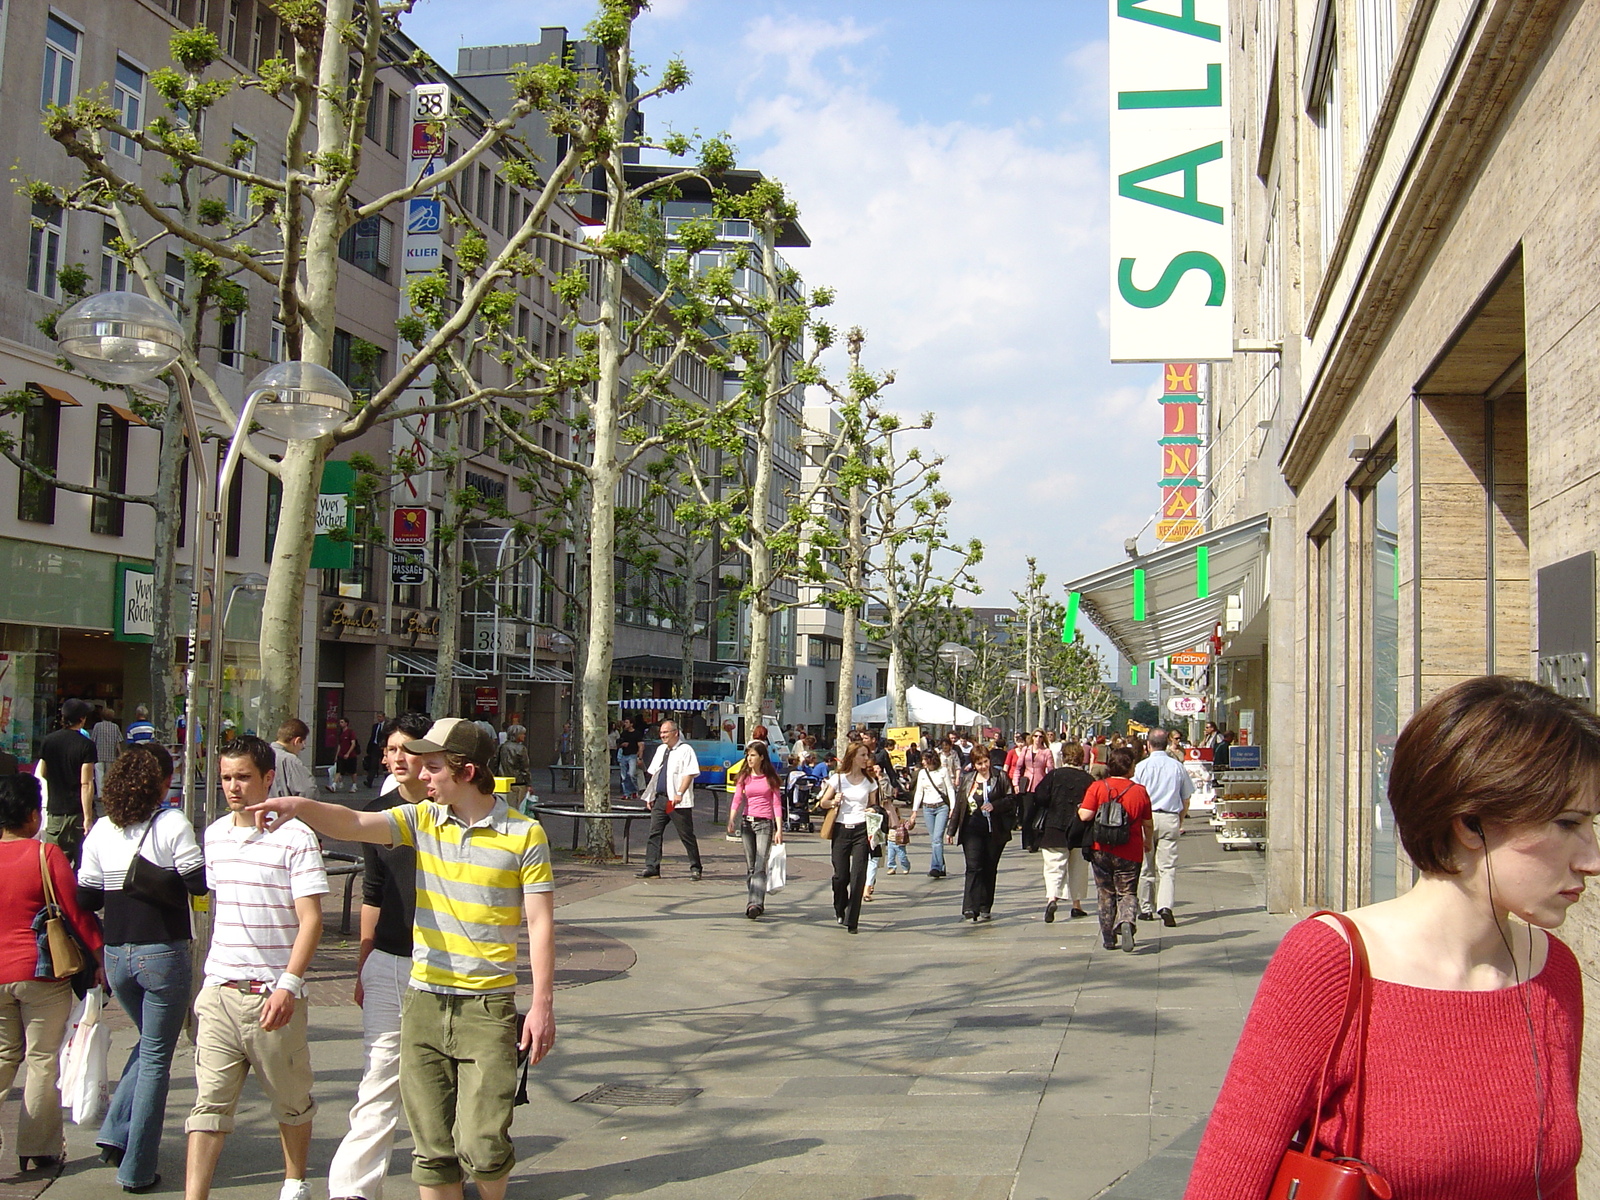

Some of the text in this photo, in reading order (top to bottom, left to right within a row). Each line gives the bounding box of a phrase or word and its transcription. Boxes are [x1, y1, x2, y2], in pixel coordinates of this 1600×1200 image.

[417, 94, 442, 115] 38
[407, 248, 438, 257] KLIER
[320, 498, 339, 515] Yves
[393, 553, 424, 564] EINNG
[392, 564, 423, 575] PASSAGE
[135, 579, 153, 604] Yves
[128, 598, 154, 623] Roche
[478, 631, 502, 650] 38
